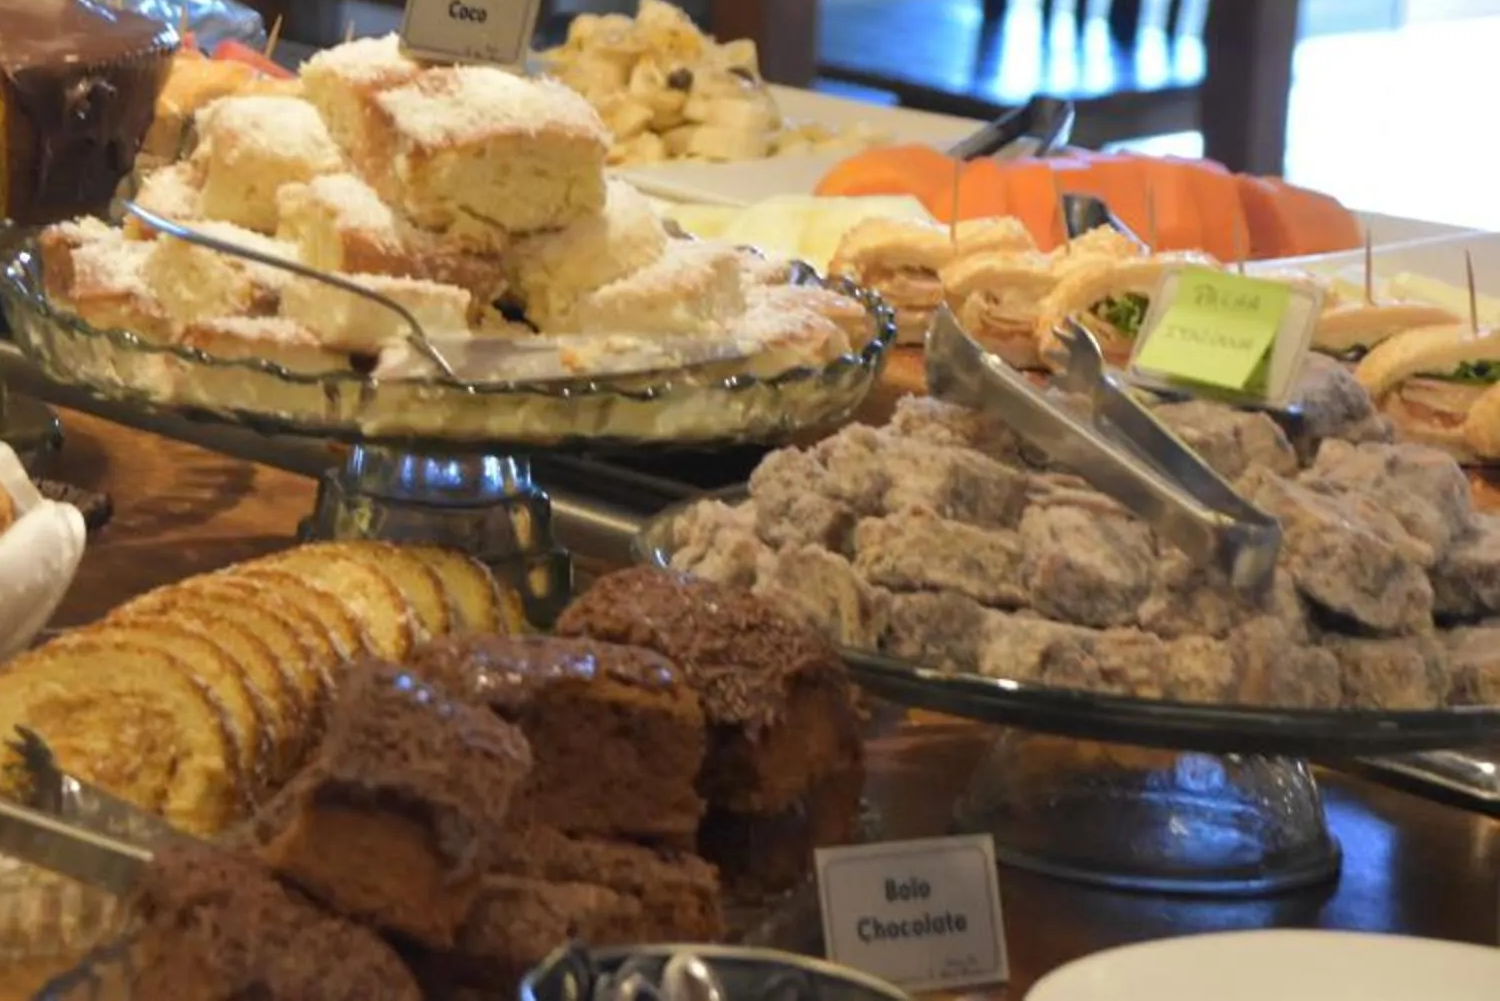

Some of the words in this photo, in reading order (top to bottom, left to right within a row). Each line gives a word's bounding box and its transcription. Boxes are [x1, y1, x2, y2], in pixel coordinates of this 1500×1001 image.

[448, 0, 488, 24] Coco
[884, 876, 931, 903] Bolo
[857, 910, 968, 944] Chocolate
